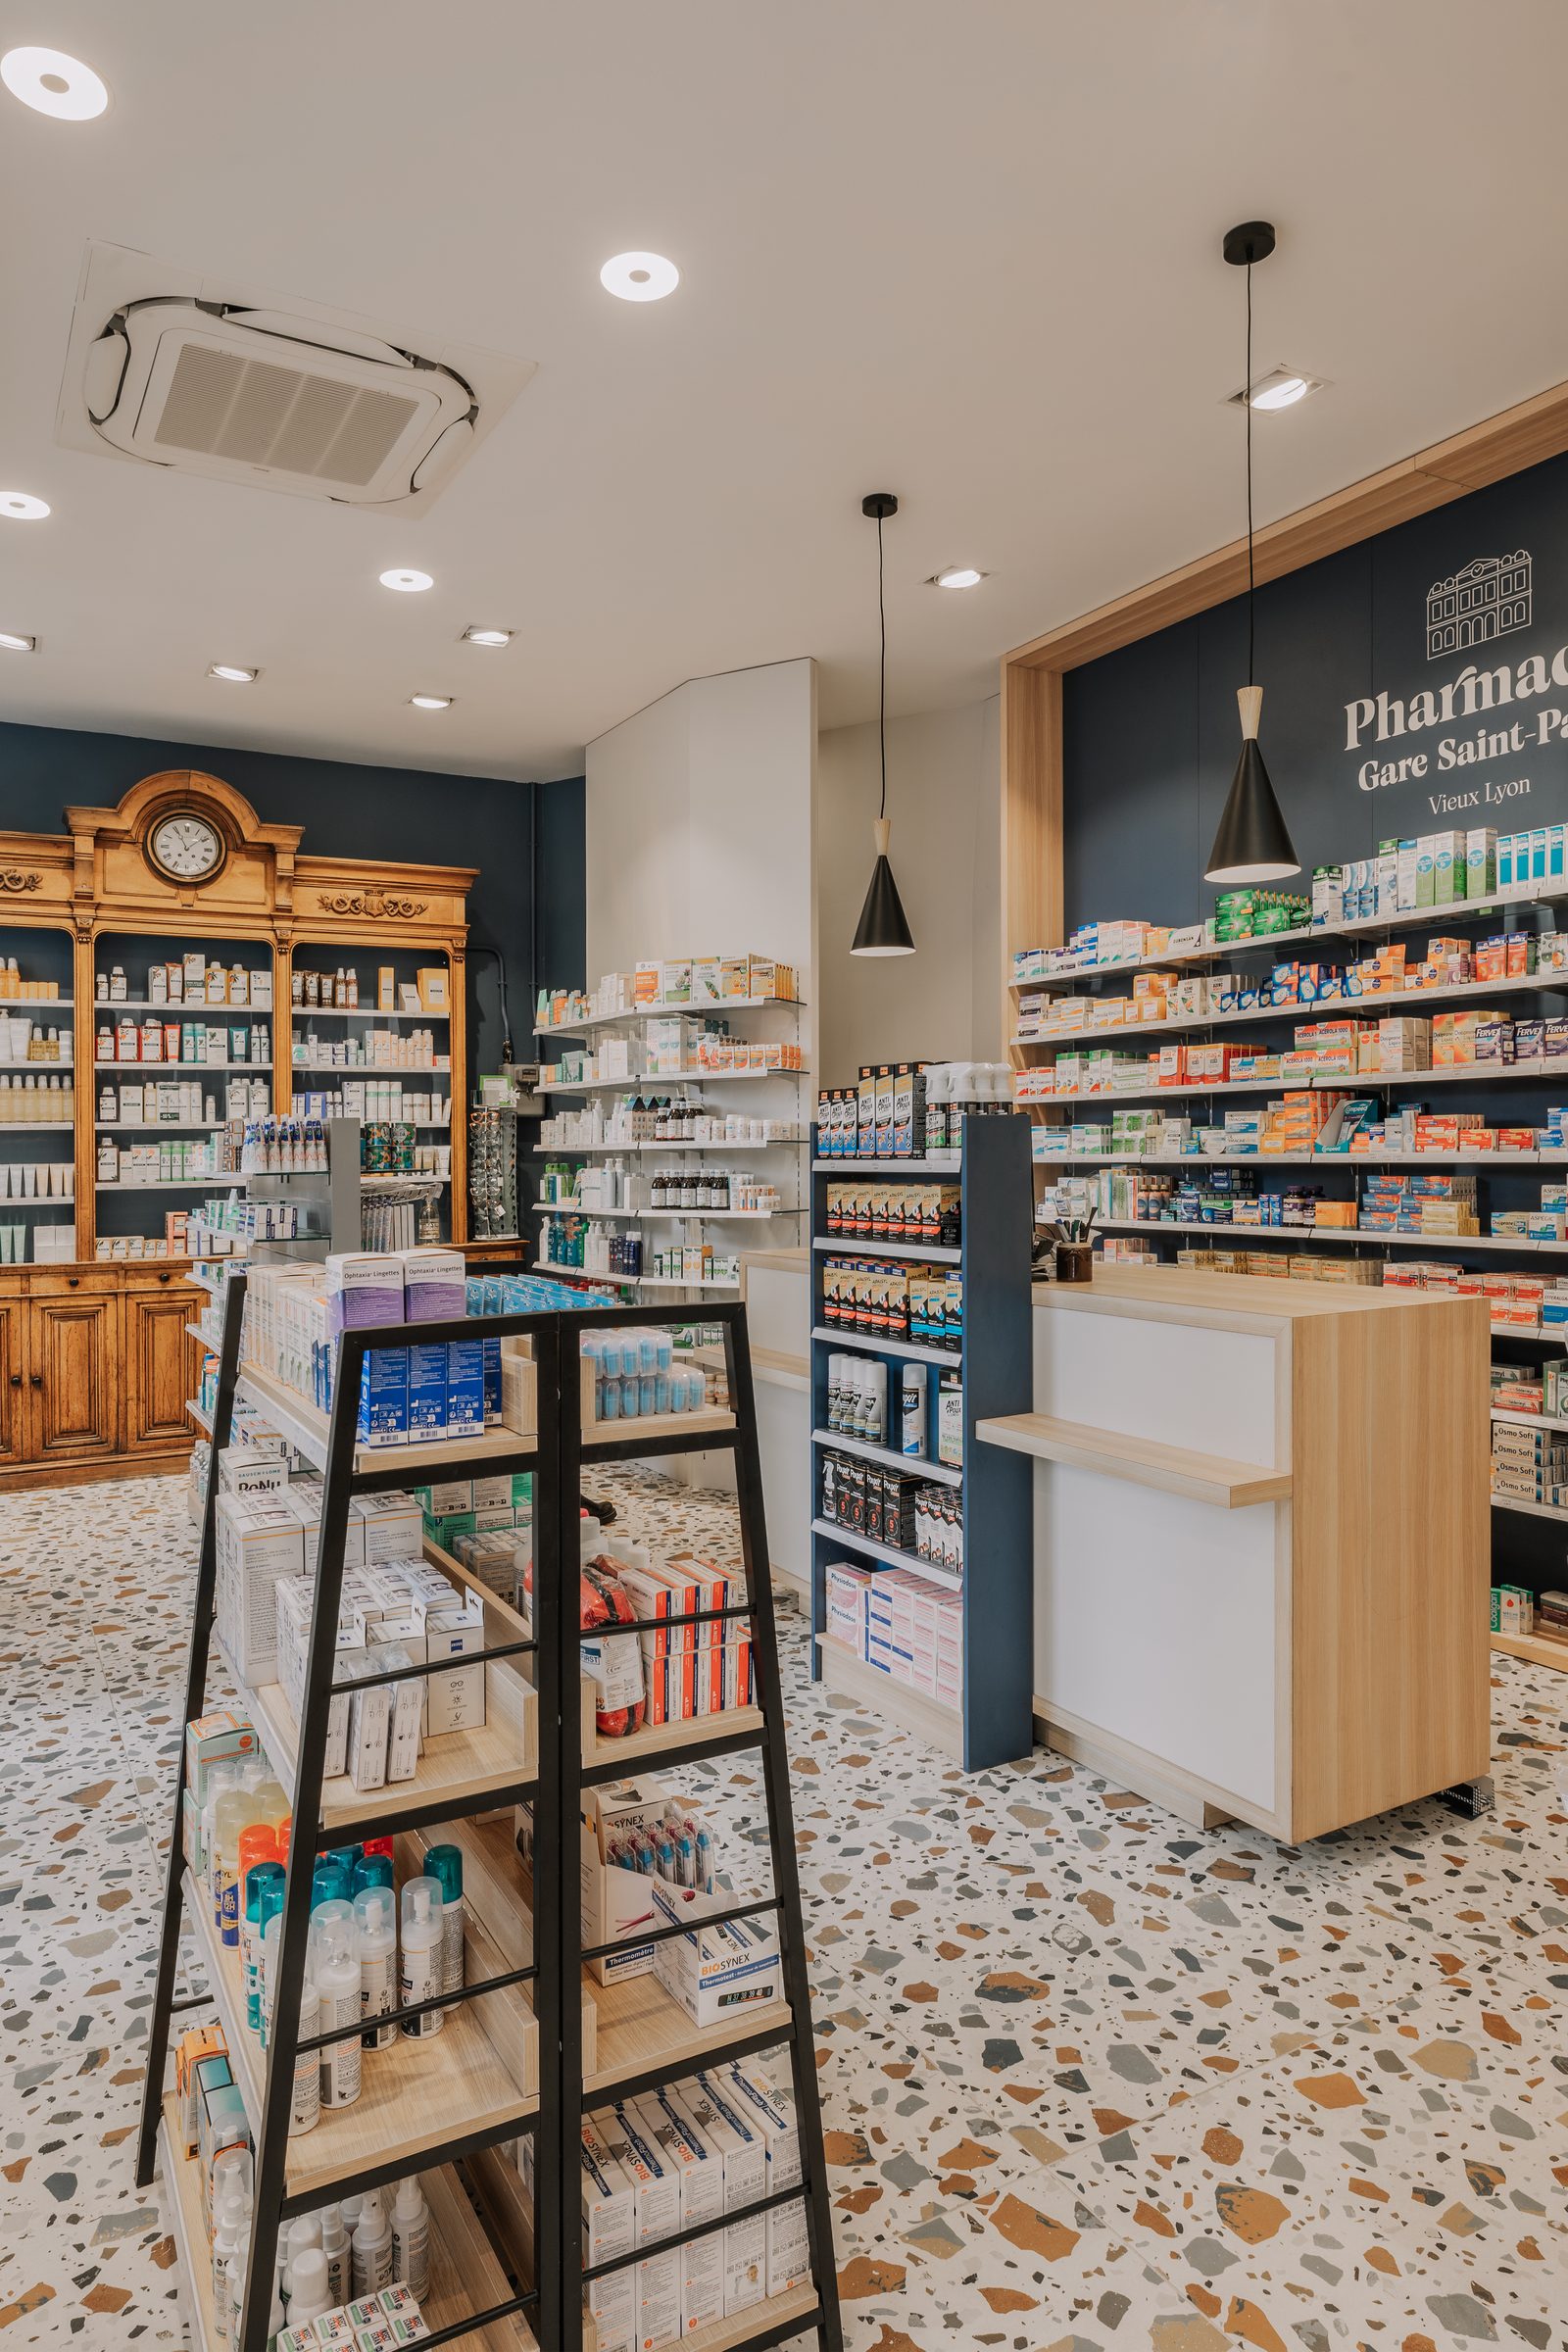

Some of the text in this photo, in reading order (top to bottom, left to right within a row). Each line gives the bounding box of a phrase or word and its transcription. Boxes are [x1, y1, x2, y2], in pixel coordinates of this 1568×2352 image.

[1358, 754, 1428, 791] Gare
[1428, 778, 1531, 815] Vieux Lyon
[1517, 1027, 1544, 1037] FERVEX
[1498, 1427, 1534, 1440] Osmo Soft
[1497, 1445, 1533, 1457] Osmo Soft
[1499, 1462, 1535, 1476] Osmo Soft
[1500, 1480, 1534, 1494] Osmo Soft
[831, 1573, 857, 1590] Physiodose
[831, 1605, 856, 1623] Physiodose
[1491, 1593, 1500, 1628] Coalgan
[702, 1972, 734, 1986] Thermotest
